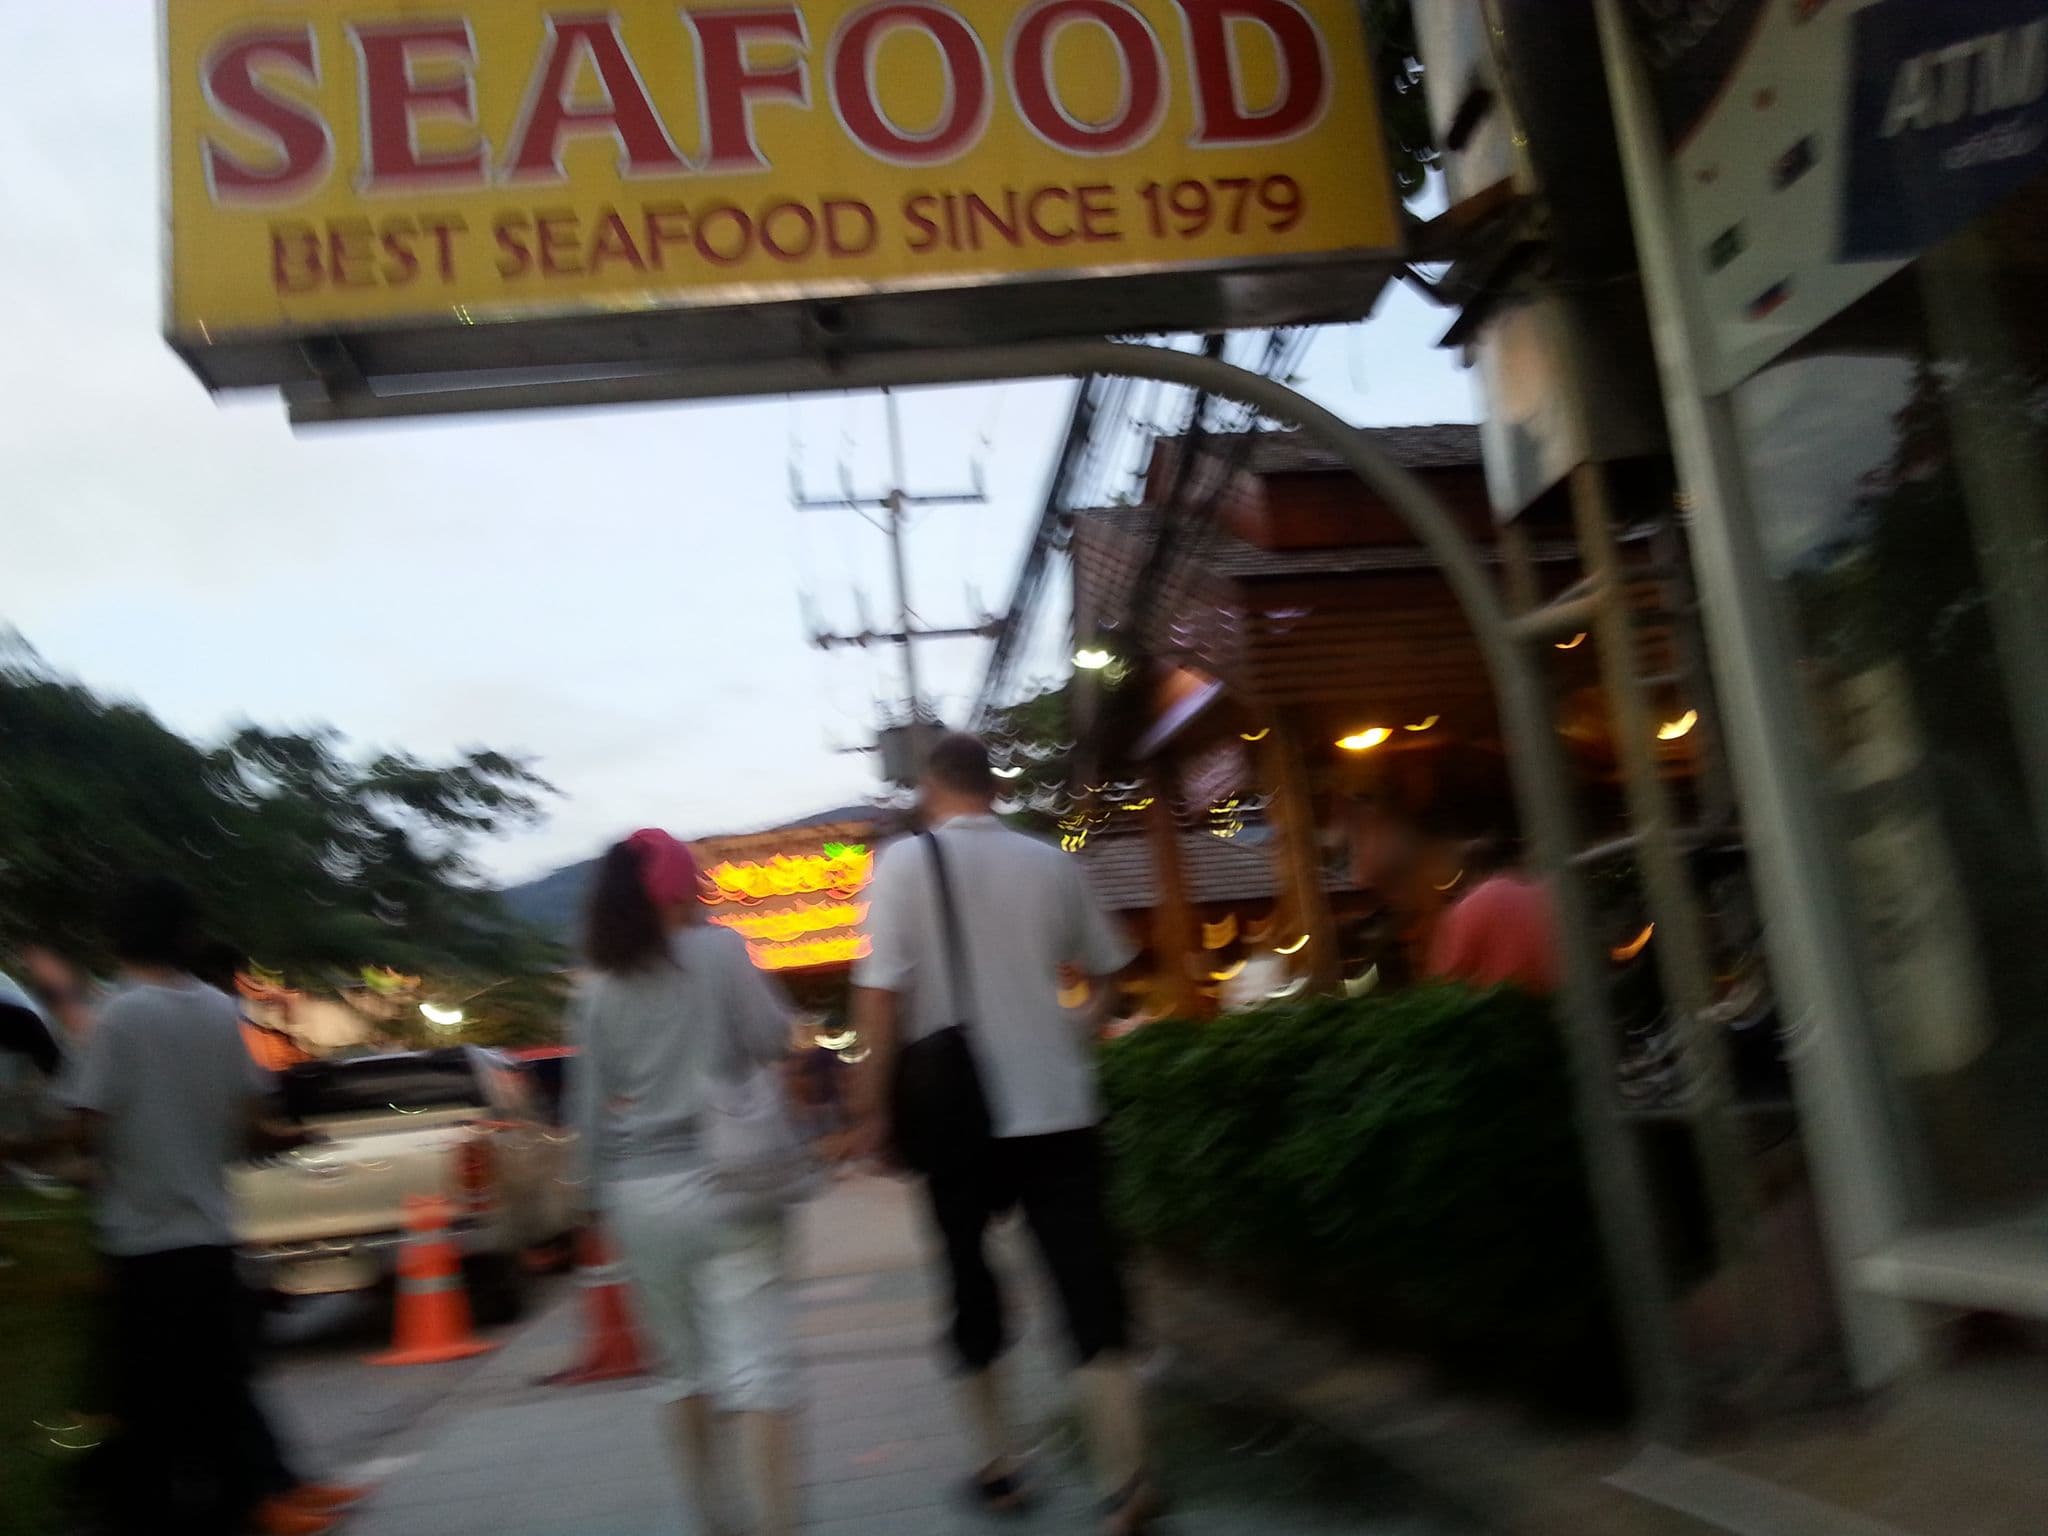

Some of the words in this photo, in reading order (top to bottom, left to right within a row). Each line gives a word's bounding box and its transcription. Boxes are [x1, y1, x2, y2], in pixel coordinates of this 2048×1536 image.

[201, 0, 1332, 208] SEAFOOD
[1881, 17, 2047, 138] ATM
[271, 208, 466, 296] BEST
[494, 199, 878, 282] SEAFOOD
[903, 184, 1121, 254] SINCE
[1142, 174, 1303, 238] 1979
